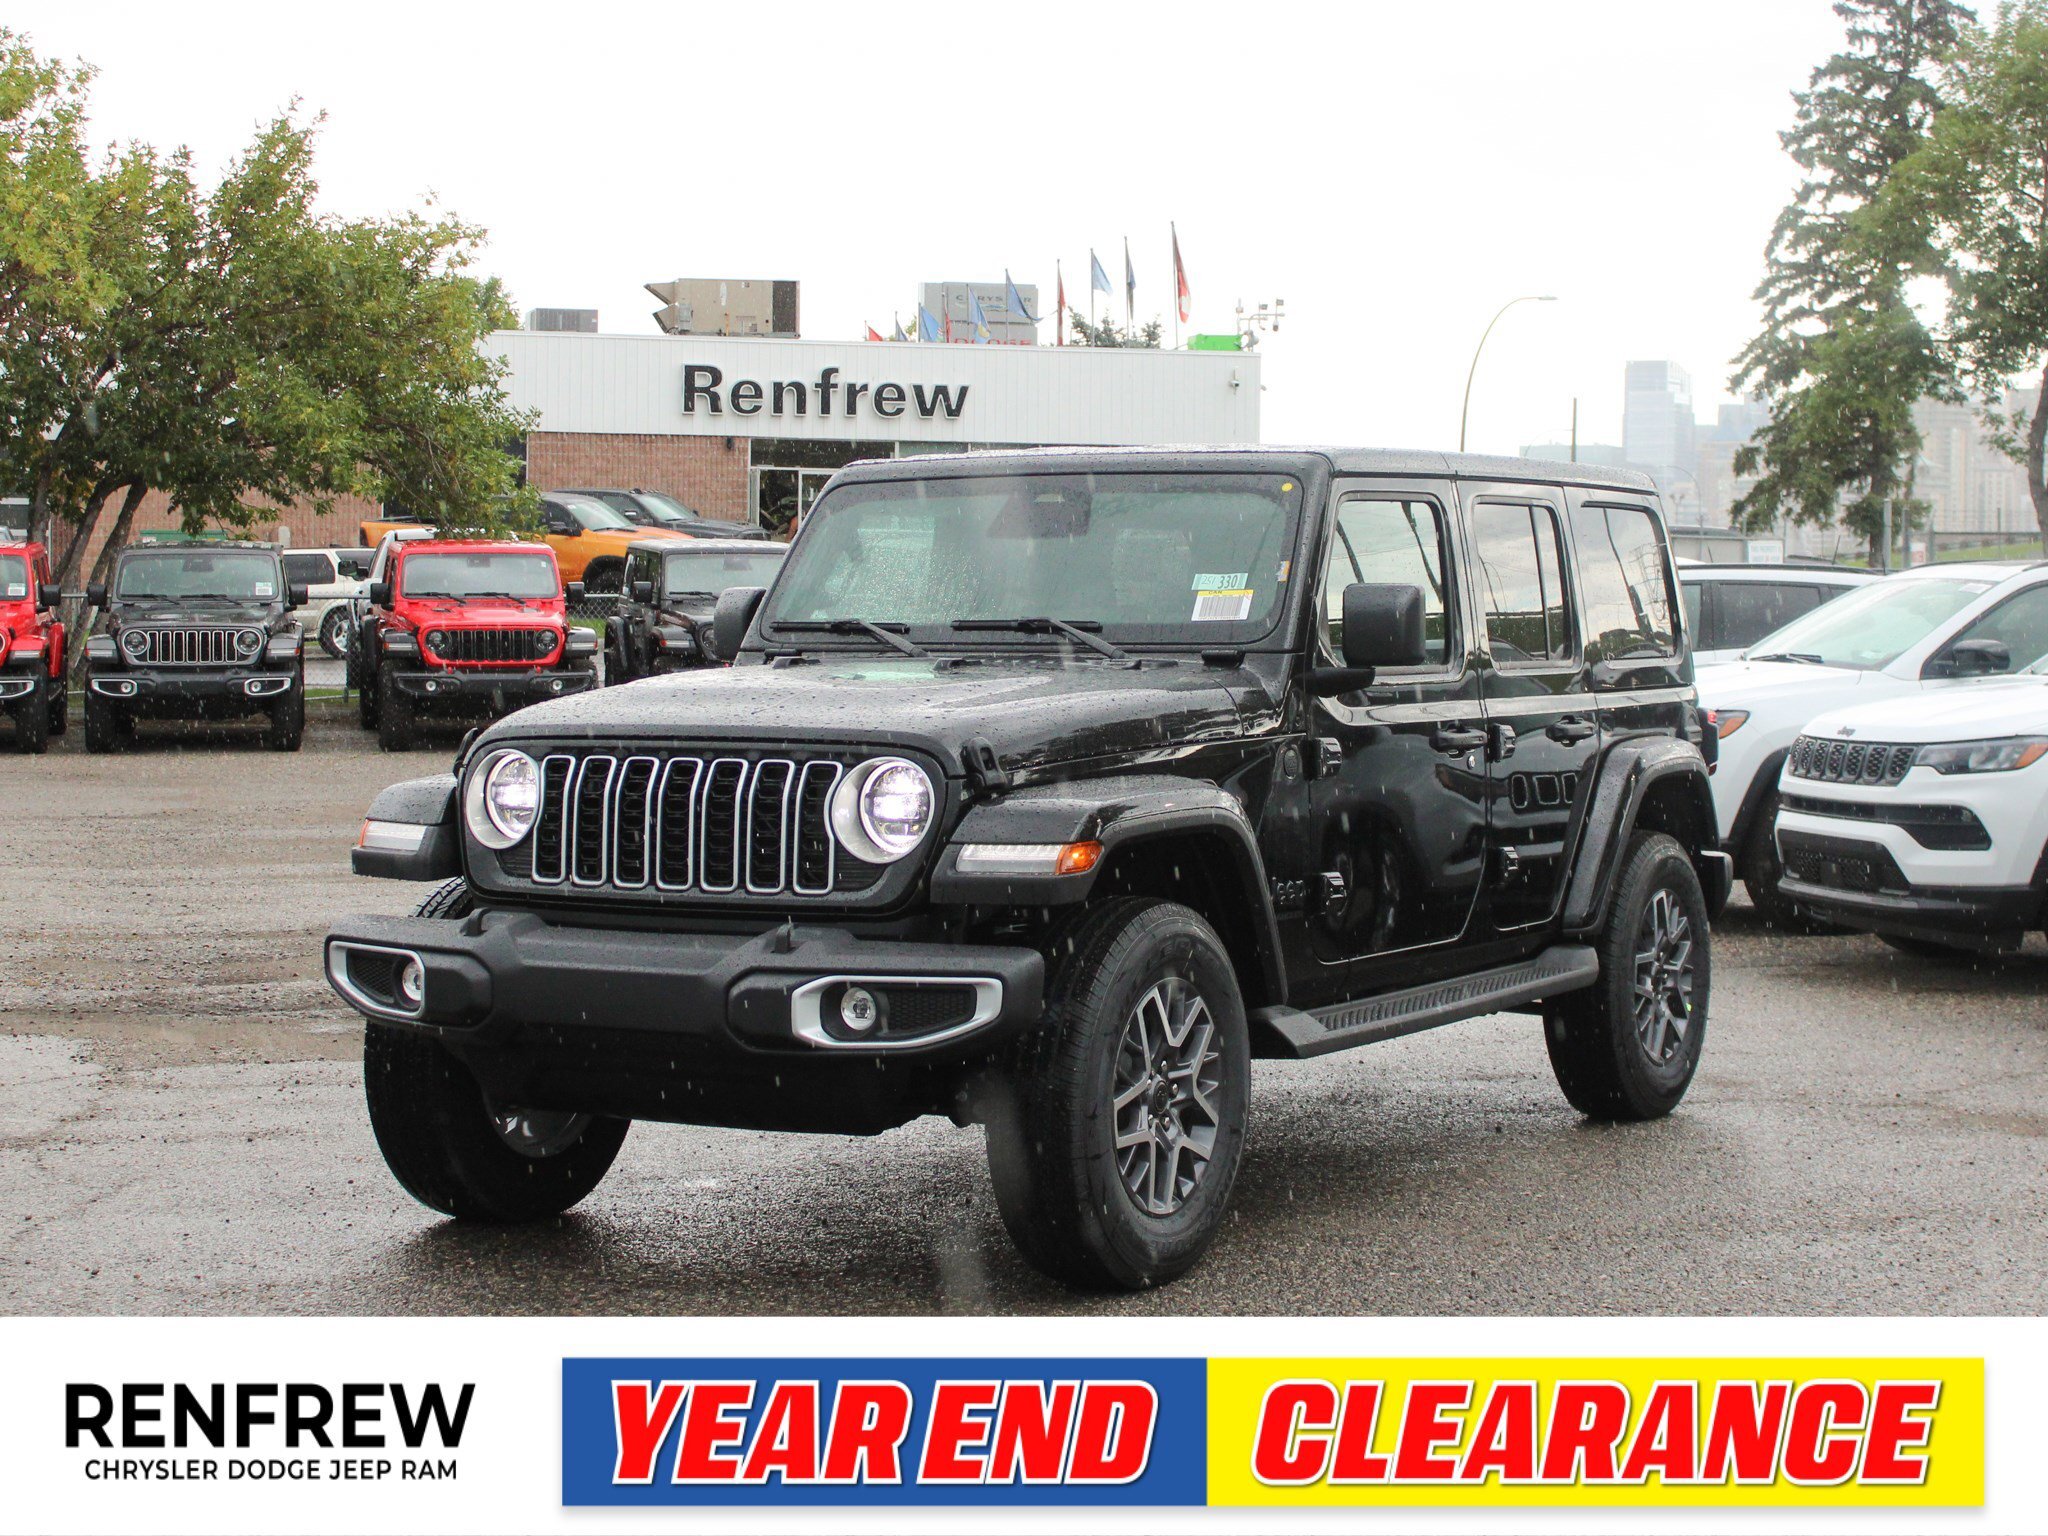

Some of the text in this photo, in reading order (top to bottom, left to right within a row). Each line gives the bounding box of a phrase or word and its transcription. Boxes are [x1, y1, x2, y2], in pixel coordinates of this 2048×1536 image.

[956, 294, 1032, 303] CRYSR
[682, 364, 969, 418] Renfrew
[1217, 575, 1238, 589] 330
